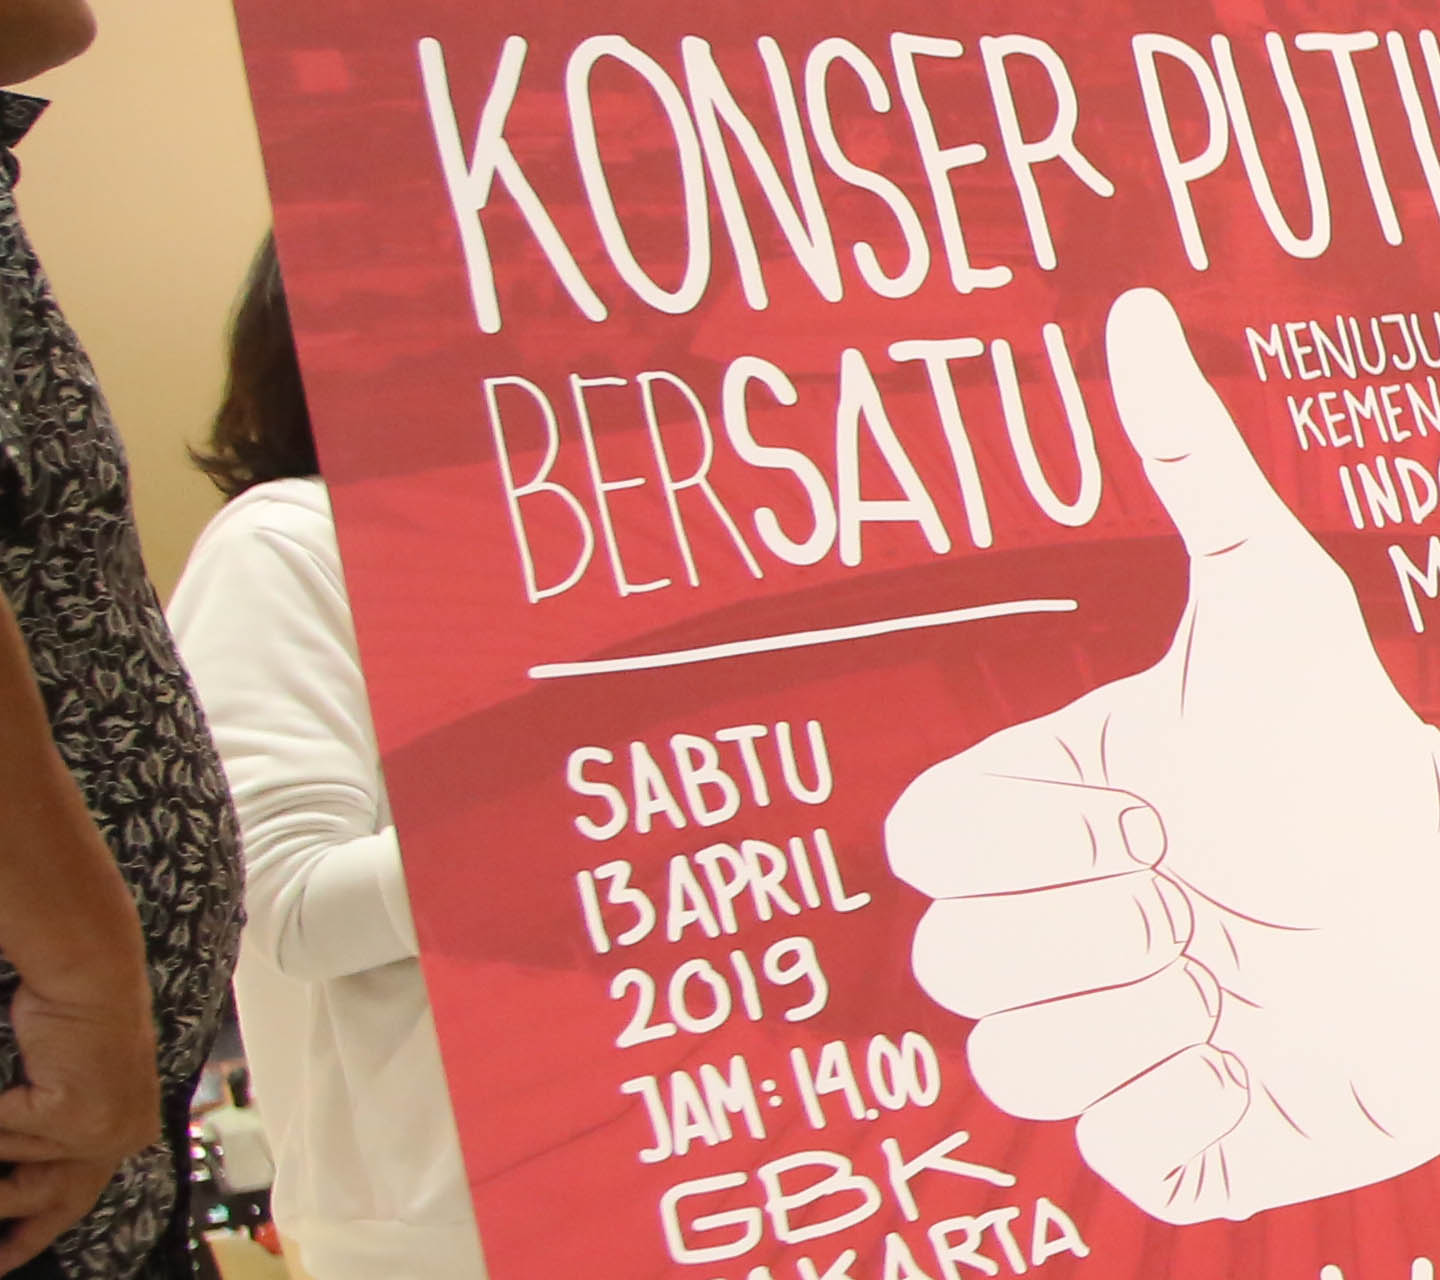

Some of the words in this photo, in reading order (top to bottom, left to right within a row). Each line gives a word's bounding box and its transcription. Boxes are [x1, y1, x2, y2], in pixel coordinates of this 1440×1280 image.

[418, 31, 1115, 334] KONSER
[483, 322, 1102, 604] BERSATU
[566, 719, 833, 841] SABTU
[576, 860, 656, 954] 13
[666, 828, 872, 942] APRIL
[610, 936, 829, 1049] 2019
[659, 1130, 1017, 1265] GBK
